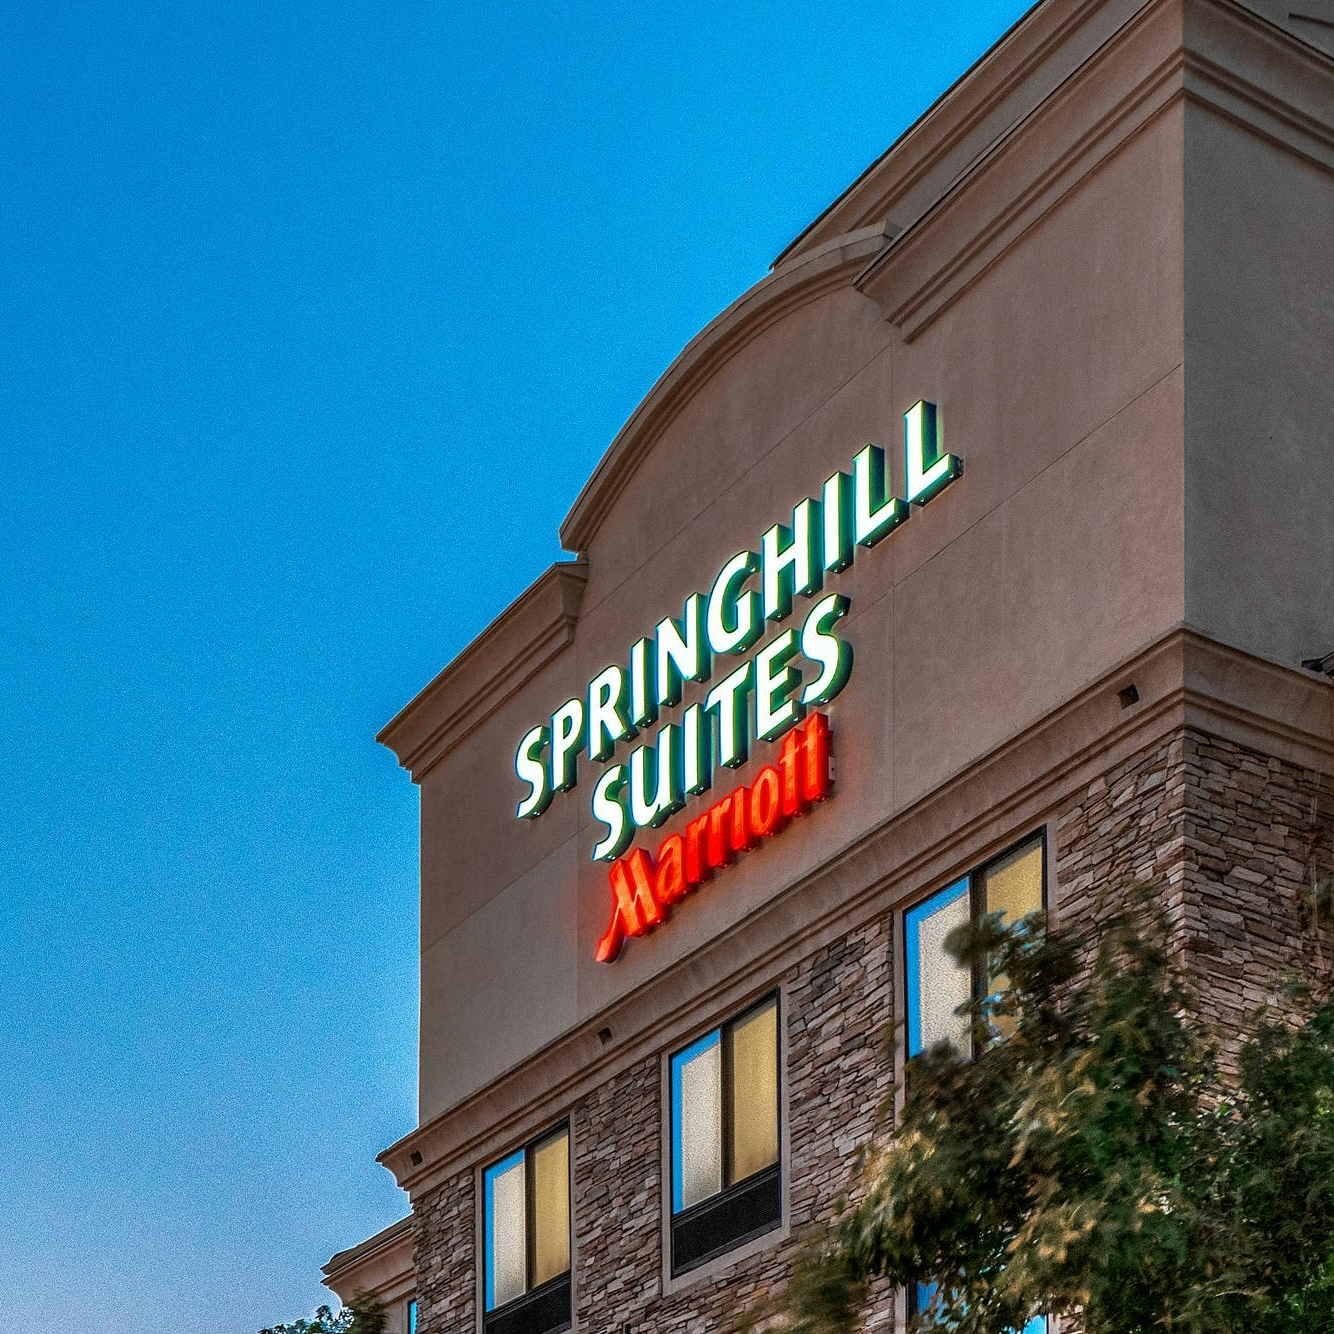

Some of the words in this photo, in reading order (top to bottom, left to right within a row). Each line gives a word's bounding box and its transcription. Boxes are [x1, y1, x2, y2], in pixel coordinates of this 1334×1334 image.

[516, 399, 963, 820] SPRINGHILL
[592, 593, 853, 862] SUITES
[596, 711, 833, 963] Marriott
